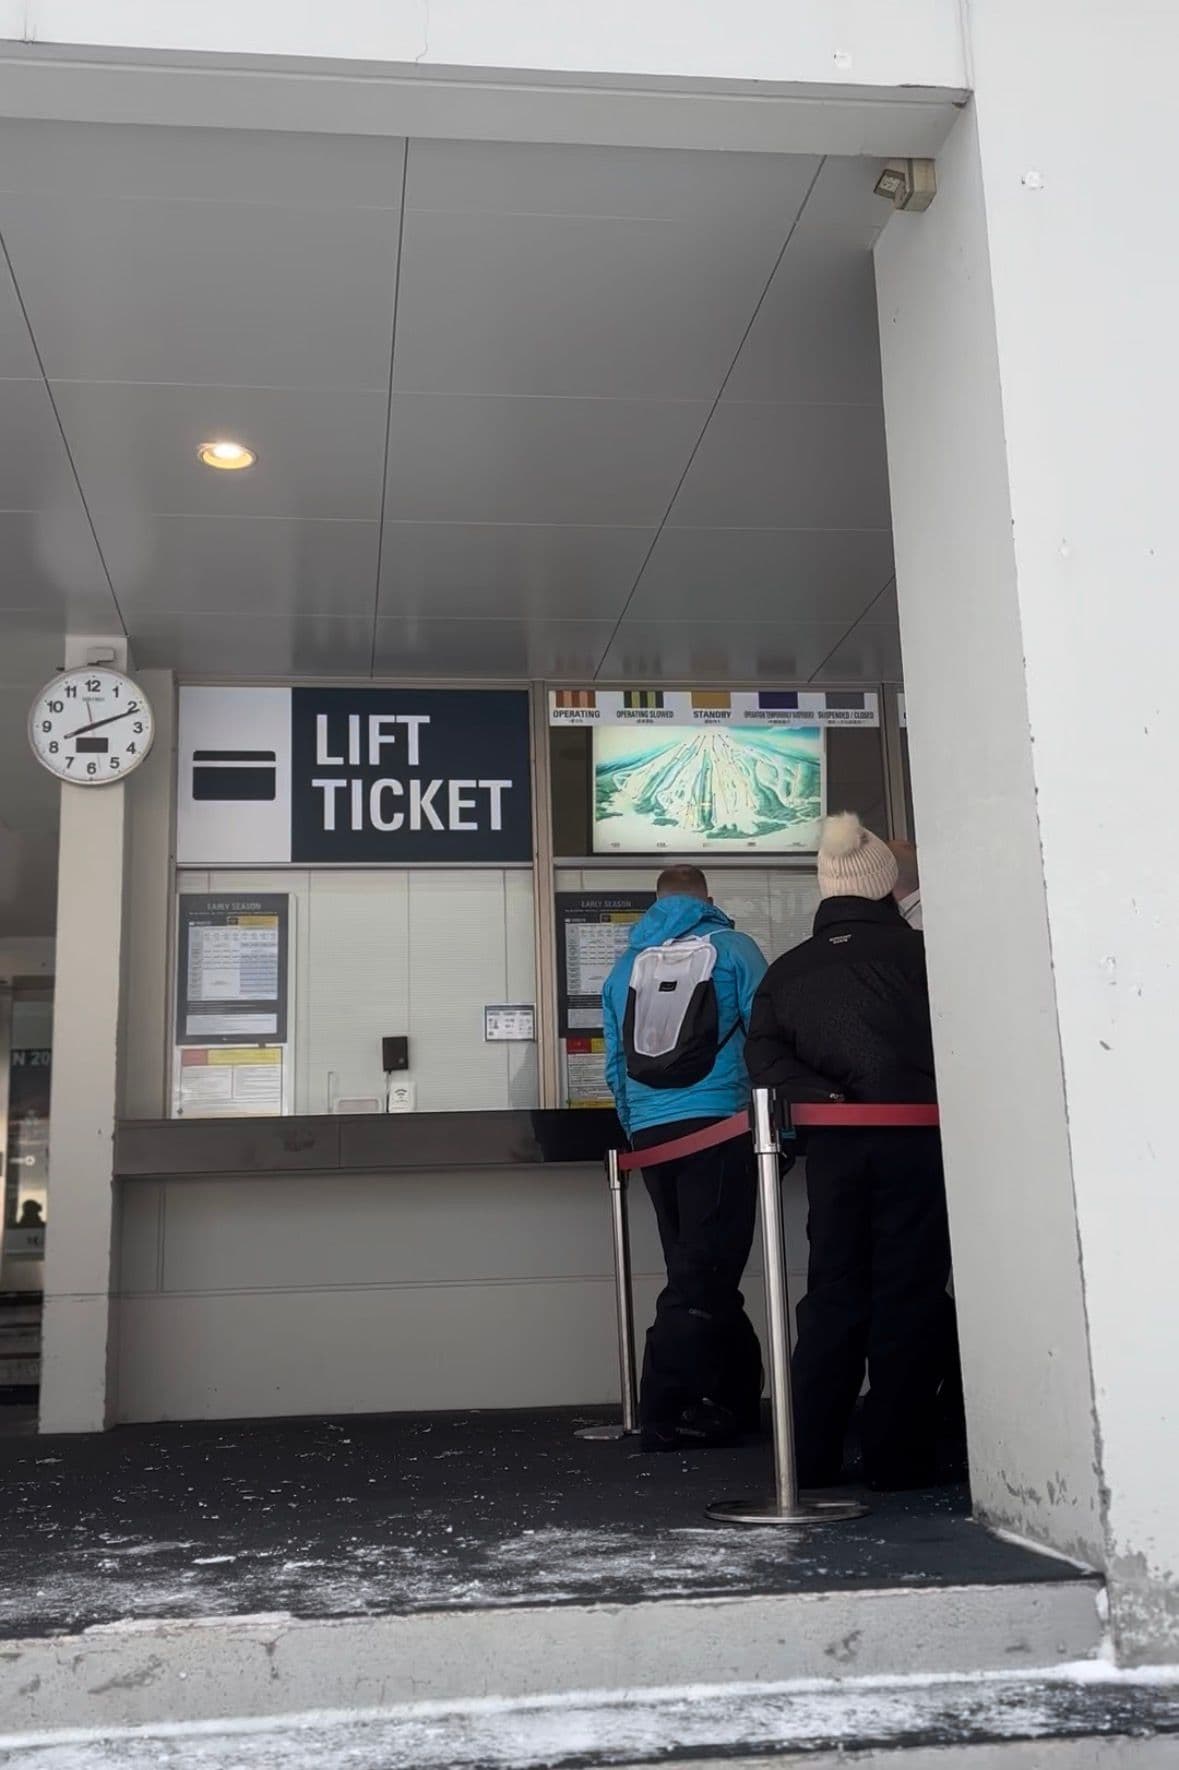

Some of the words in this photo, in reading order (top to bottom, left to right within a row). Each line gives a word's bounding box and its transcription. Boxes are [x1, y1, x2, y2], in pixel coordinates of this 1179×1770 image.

[65, 686, 77, 698] 11
[85, 680, 101, 692] 12
[112, 686, 119, 698] 1
[47, 701, 64, 713] 10
[127, 701, 138, 713] 2
[553, 710, 600, 718] OPERATING
[693, 710, 731, 719] STANDBY
[42, 721, 52, 732] 9
[133, 722, 143, 733] 3
[316, 714, 431, 765] LIFT
[49, 741, 59, 753] 8
[126, 742, 136, 754] 4
[65, 756, 75, 769] 7
[87, 762, 96, 774] 6
[110, 757, 120, 769] 5
[311, 778, 513, 831] TICKET
